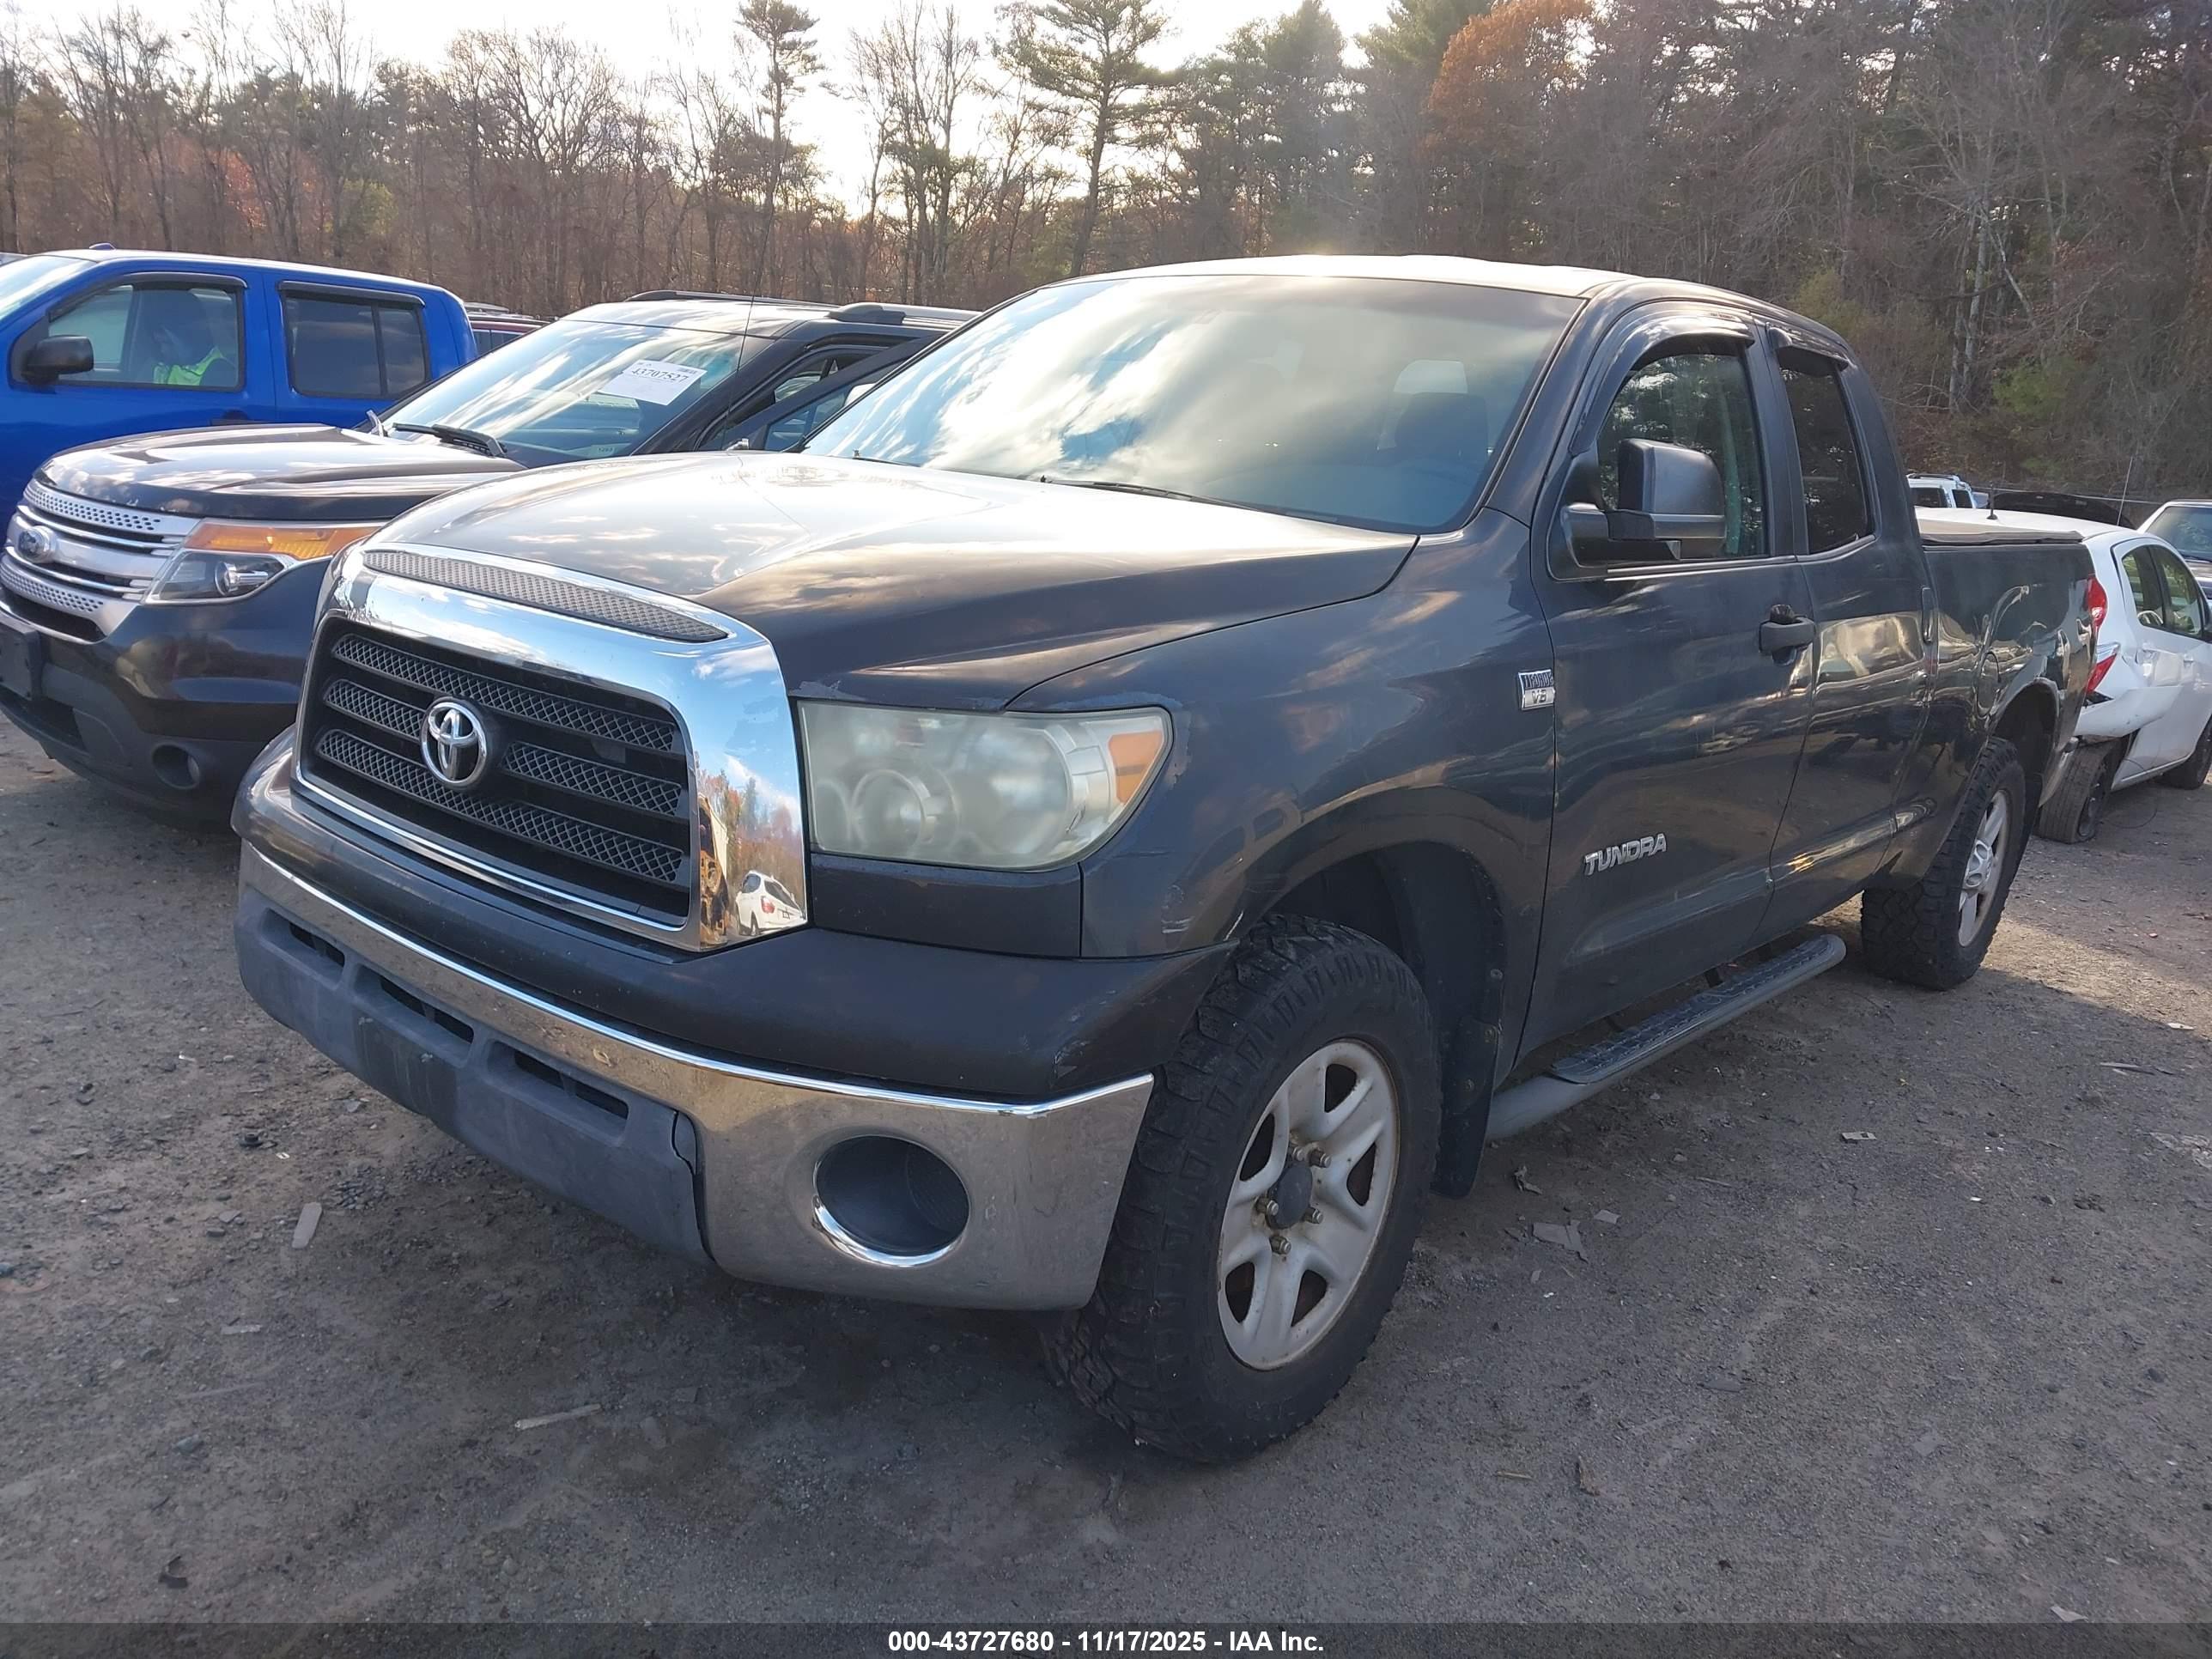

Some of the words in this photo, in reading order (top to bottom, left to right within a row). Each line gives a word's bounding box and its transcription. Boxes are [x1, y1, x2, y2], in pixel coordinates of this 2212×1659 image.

[631, 367, 690, 382] 43707527
[1531, 689, 1547, 704] V8
[1583, 832, 1668, 877] TUNDRA
